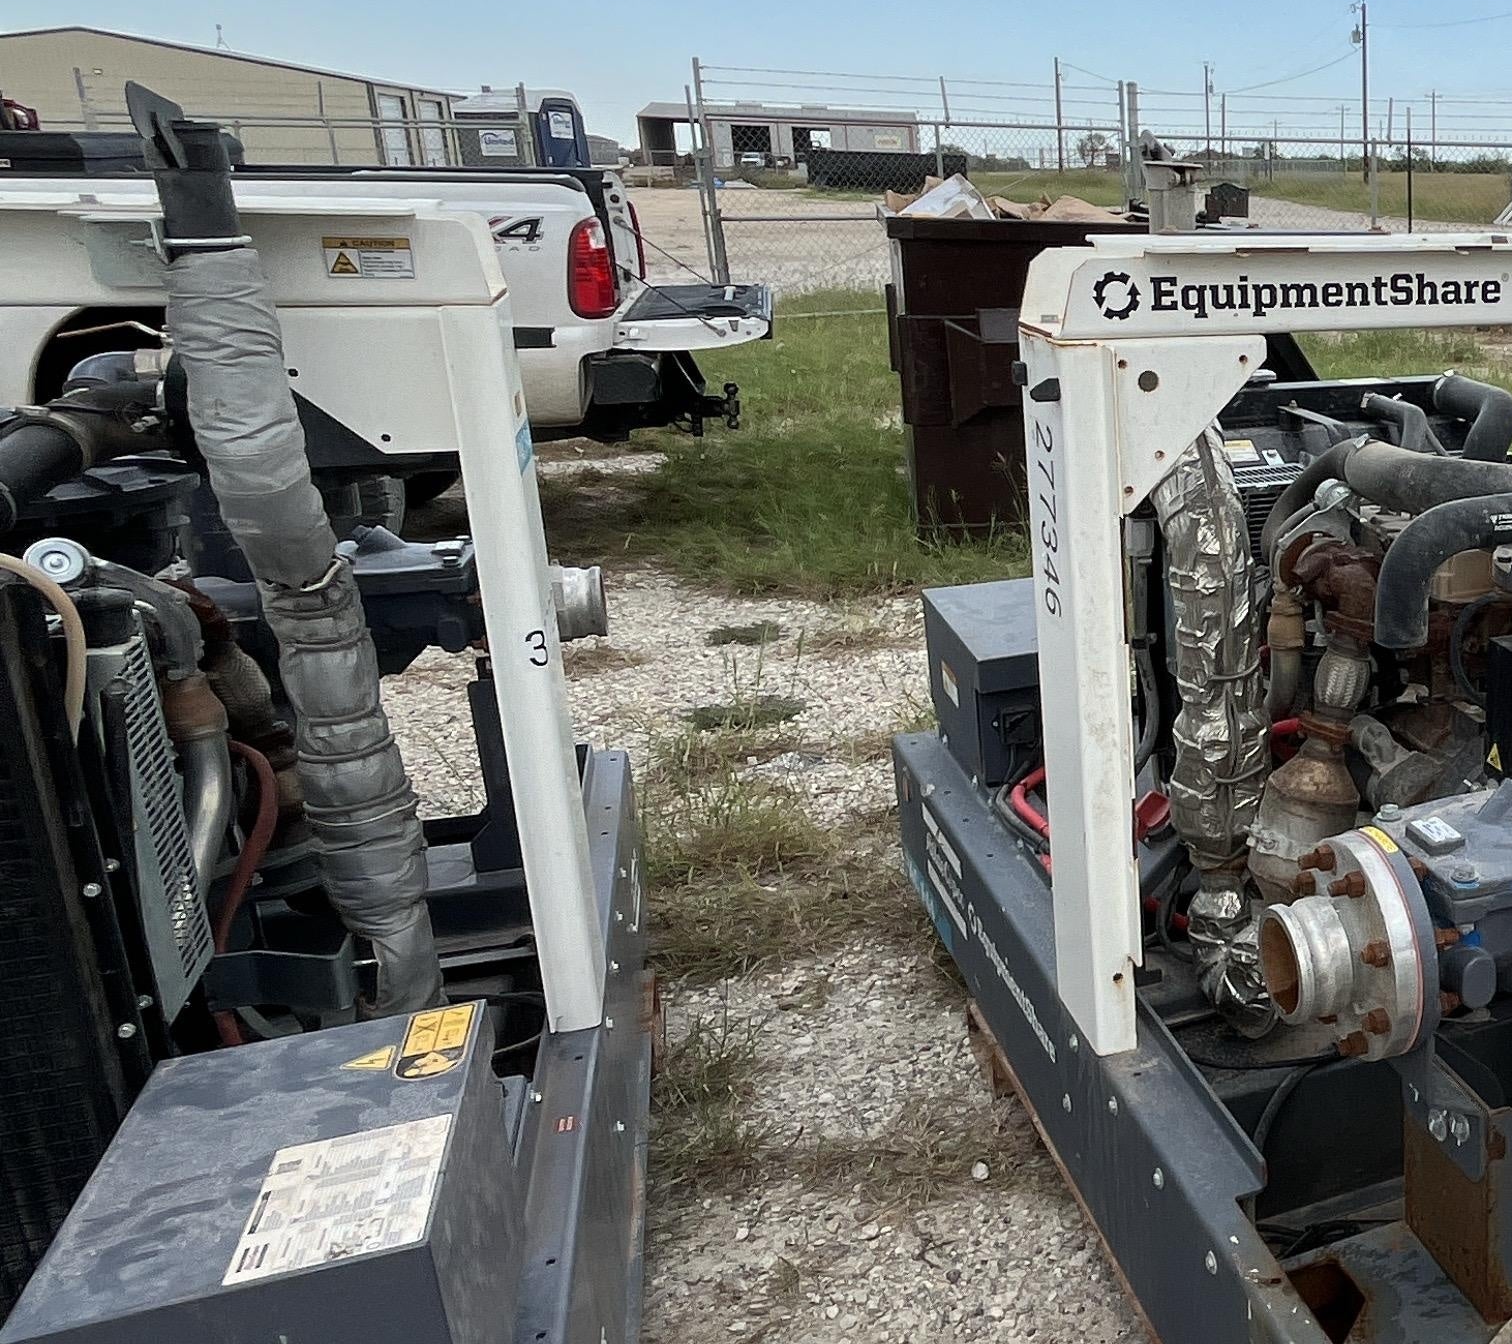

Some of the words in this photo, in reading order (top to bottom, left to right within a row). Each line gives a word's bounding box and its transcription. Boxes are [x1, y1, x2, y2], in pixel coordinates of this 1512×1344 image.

[1150, 273, 1502, 320] EquipmentShare
[1035, 419, 1062, 618] 277346
[525, 630, 548, 666] 3
